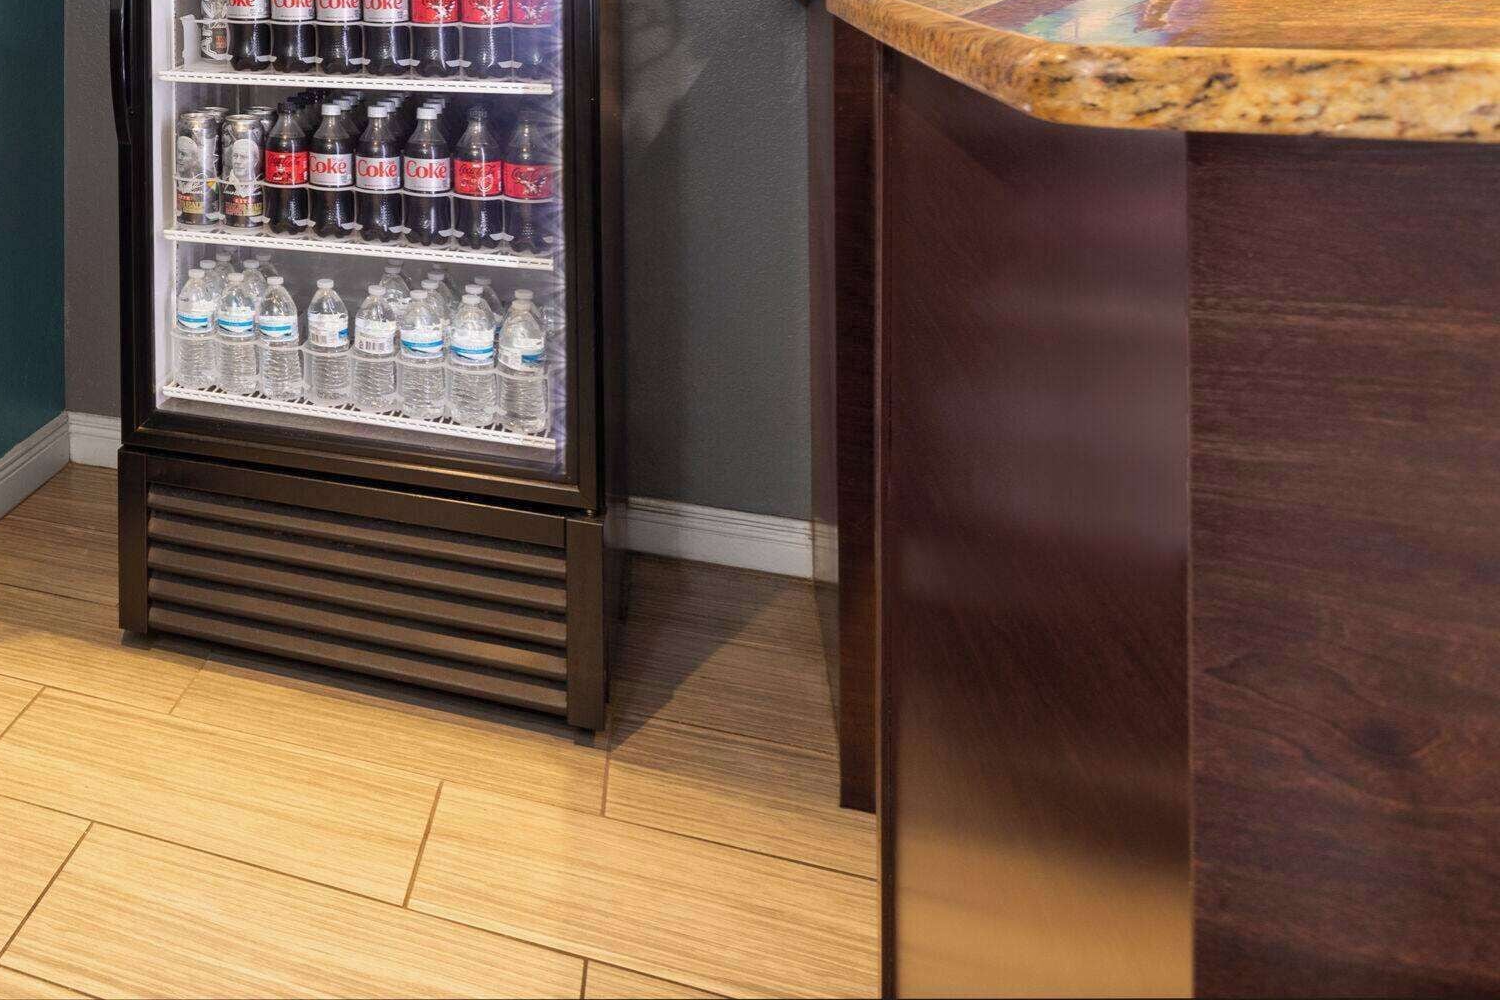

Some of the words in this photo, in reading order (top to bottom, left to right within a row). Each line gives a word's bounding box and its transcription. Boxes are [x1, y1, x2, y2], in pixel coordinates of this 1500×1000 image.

[308, 155, 348, 174] Coke
[357, 159, 399, 179] Coke
[405, 159, 448, 179] Coke
